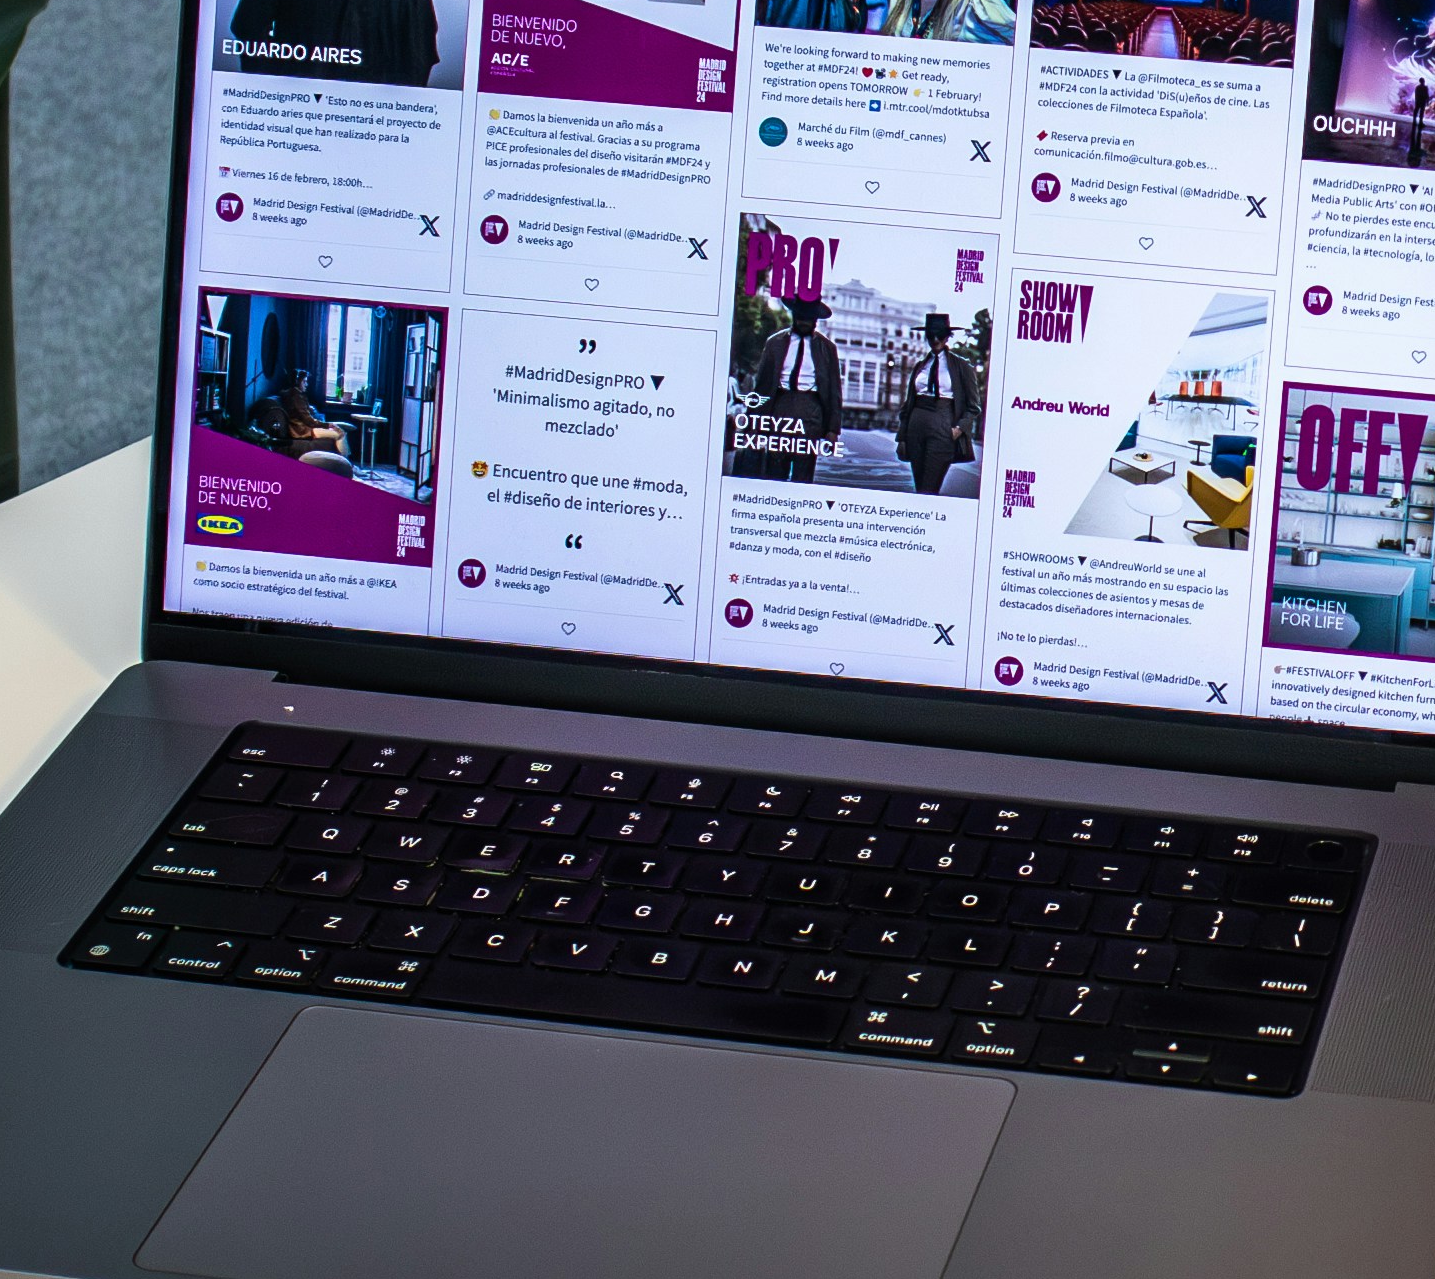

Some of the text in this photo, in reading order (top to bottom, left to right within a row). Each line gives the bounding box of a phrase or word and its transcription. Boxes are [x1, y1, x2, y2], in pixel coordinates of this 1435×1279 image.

[492, 13, 577, 33] BIENVENIDO
[490, 29, 566, 49] DE NUEVO,
[221, 38, 362, 65] EDUARDO AIRES
[490, 52, 529, 67] AC/E
[764, 42, 990, 70] We're looking forward to making new memories
[762, 76, 982, 104] registration opens TOMORROW 1 February!
[1038, 81, 1270, 109] #MDF24 con la actividad 'DiS(u)eños de cine. Las
[797, 121, 947, 144] Marché du Film (@mdf_cannes)
[1313, 114, 1396, 138] OUCHHH
[1311, 193, 1341, 205] Media
[1342, 195, 1373, 208] Public
[1374, 198, 1397, 210] Arts'
[1399, 202, 1417, 211] con
[1019, 279, 1079, 313] SHOW
[1016, 309, 1073, 344] ROOM
[504, 364, 645, 390] #MadridDesignPRO
[492, 387, 675, 419] 'Minimalismo agitado, no
[1010, 396, 1110, 417] Andreu World
[544, 420, 619, 438] mezclado'
[732, 410, 805, 434] OTEYZA
[733, 432, 846, 458] EXPERIENCE
[198, 474, 282, 495] BIENVENIDO
[492, 463, 688, 497] Encuentro que une #moda,
[1004, 468, 1036, 484] MADRID
[1003, 481, 1031, 495] DESIGN
[197, 489, 271, 511] DE NUEVO,
[486, 487, 500, 503] el
[503, 489, 561, 508] #diseño
[563, 494, 582, 510] de
[585, 496, 655, 517] interiores
[732, 493, 946, 521] #MadridDesignPRO 'OTEYZA Experience' La
[1003, 493, 1035, 508] FESTIVAL
[1002, 505, 1012, 518] 24
[200, 517, 240, 532] IKEA
[1278, 595, 1346, 616] KITCHEN
[1280, 611, 1345, 630] FOR LIFE
[182, 823, 205, 831] tab
[152, 864, 216, 876] caps lock
[322, 828, 1059, 913] Q W E R T Y U I O P
[1289, 894, 1333, 905] delete
[120, 905, 154, 915] shift
[136, 931, 151, 940] fn
[168, 957, 220, 968] control
[254, 967, 301, 977] option
[333, 976, 406, 989] command
[1261, 980, 1307, 991] return
[858, 1032, 933, 1046] command
[1257, 1025, 1292, 1036] shift
[966, 1043, 1014, 1055] option
